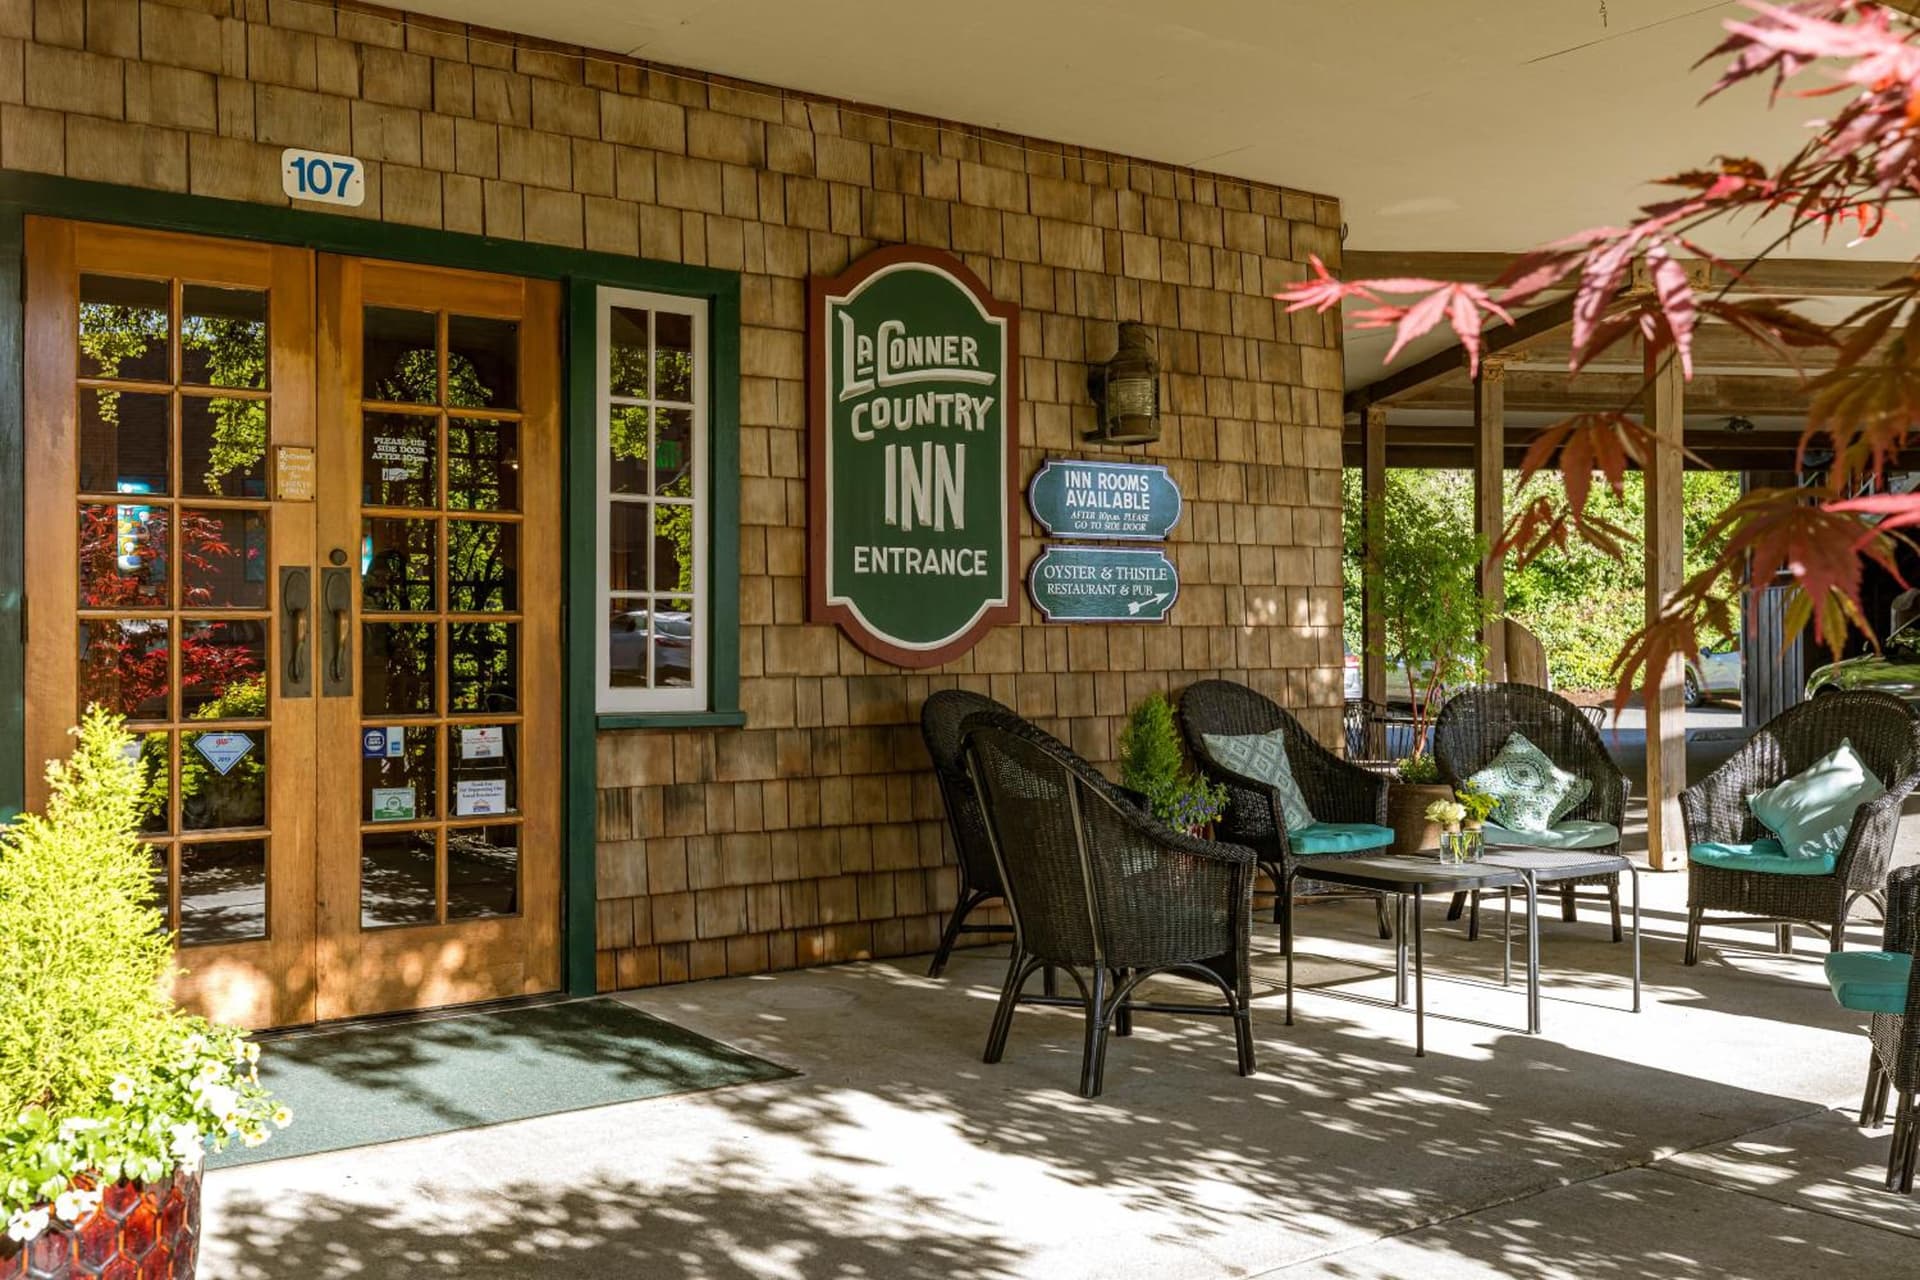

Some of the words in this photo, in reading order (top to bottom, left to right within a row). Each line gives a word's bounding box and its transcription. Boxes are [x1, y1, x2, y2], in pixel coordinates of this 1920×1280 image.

[290, 157, 355, 198] 107
[877, 320, 997, 388] CONNER
[851, 391, 995, 441] COUNTRY
[373, 436, 407, 446] PLEASE
[410, 439, 428, 448] USE
[376, 444, 398, 453] SIDE
[399, 446, 426, 455] DOOR
[371, 452, 401, 460] AFTER
[885, 441, 966, 532] INN
[1065, 470, 1092, 489] INN
[1098, 472, 1150, 492] ROOMS
[1065, 489, 1151, 511] AVAILABLE
[1070, 511, 1096, 520] AFTER
[1123, 512, 1151, 522] PLEASE
[1074, 520, 1088, 530] GO
[1090, 520, 1102, 530] TO
[1104, 521, 1120, 531] SIDE
[1122, 522, 1147, 531] DOOR
[854, 546, 989, 577] ENTRANCE
[1043, 564, 1097, 580] OYSTER
[1100, 566, 1113, 580] &
[1115, 566, 1169, 581] THISTLE
[1047, 582, 1117, 596] RESTAURANT
[1119, 584, 1130, 597] &
[1132, 584, 1154, 597] PUB
